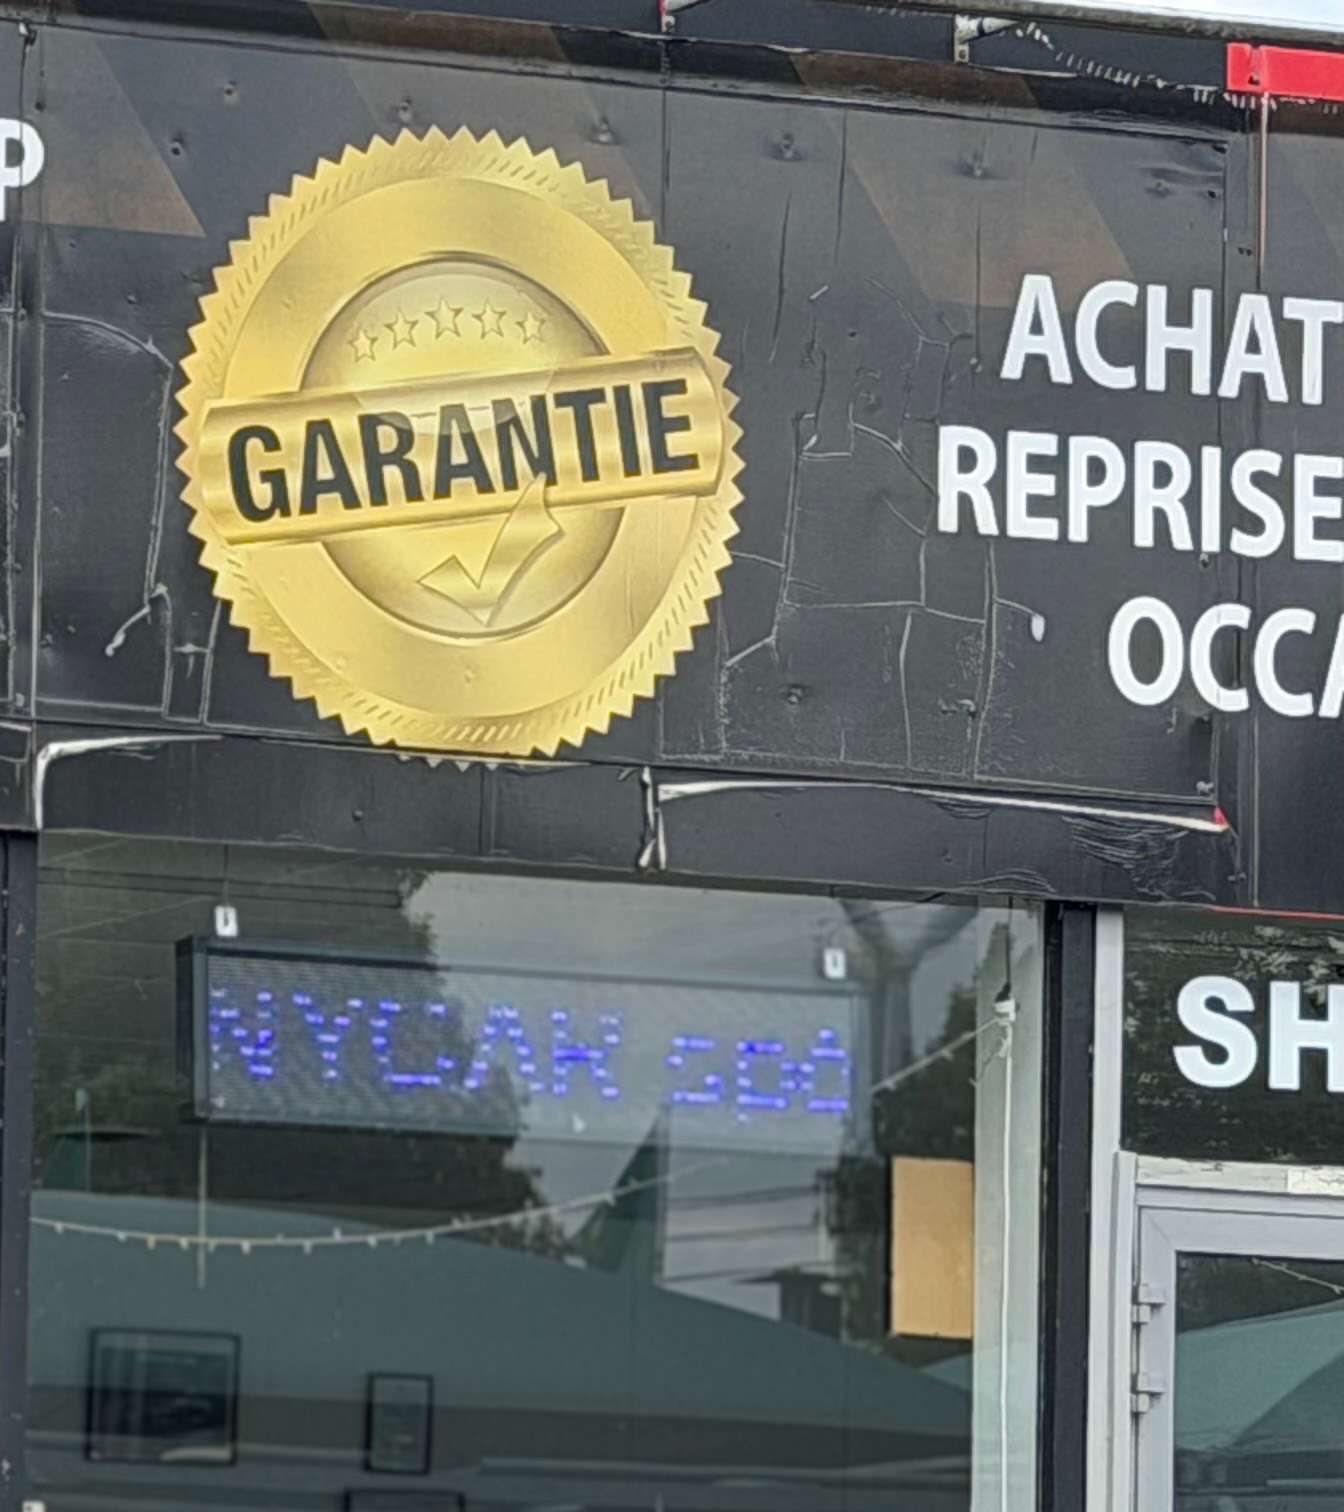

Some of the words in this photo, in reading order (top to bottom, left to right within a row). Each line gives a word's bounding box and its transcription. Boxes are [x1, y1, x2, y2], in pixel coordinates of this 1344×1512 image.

[1000, 274, 1344, 405] ACHAT
[227, 378, 701, 525] GARANTIE
[937, 424, 1344, 562] REPRISE
